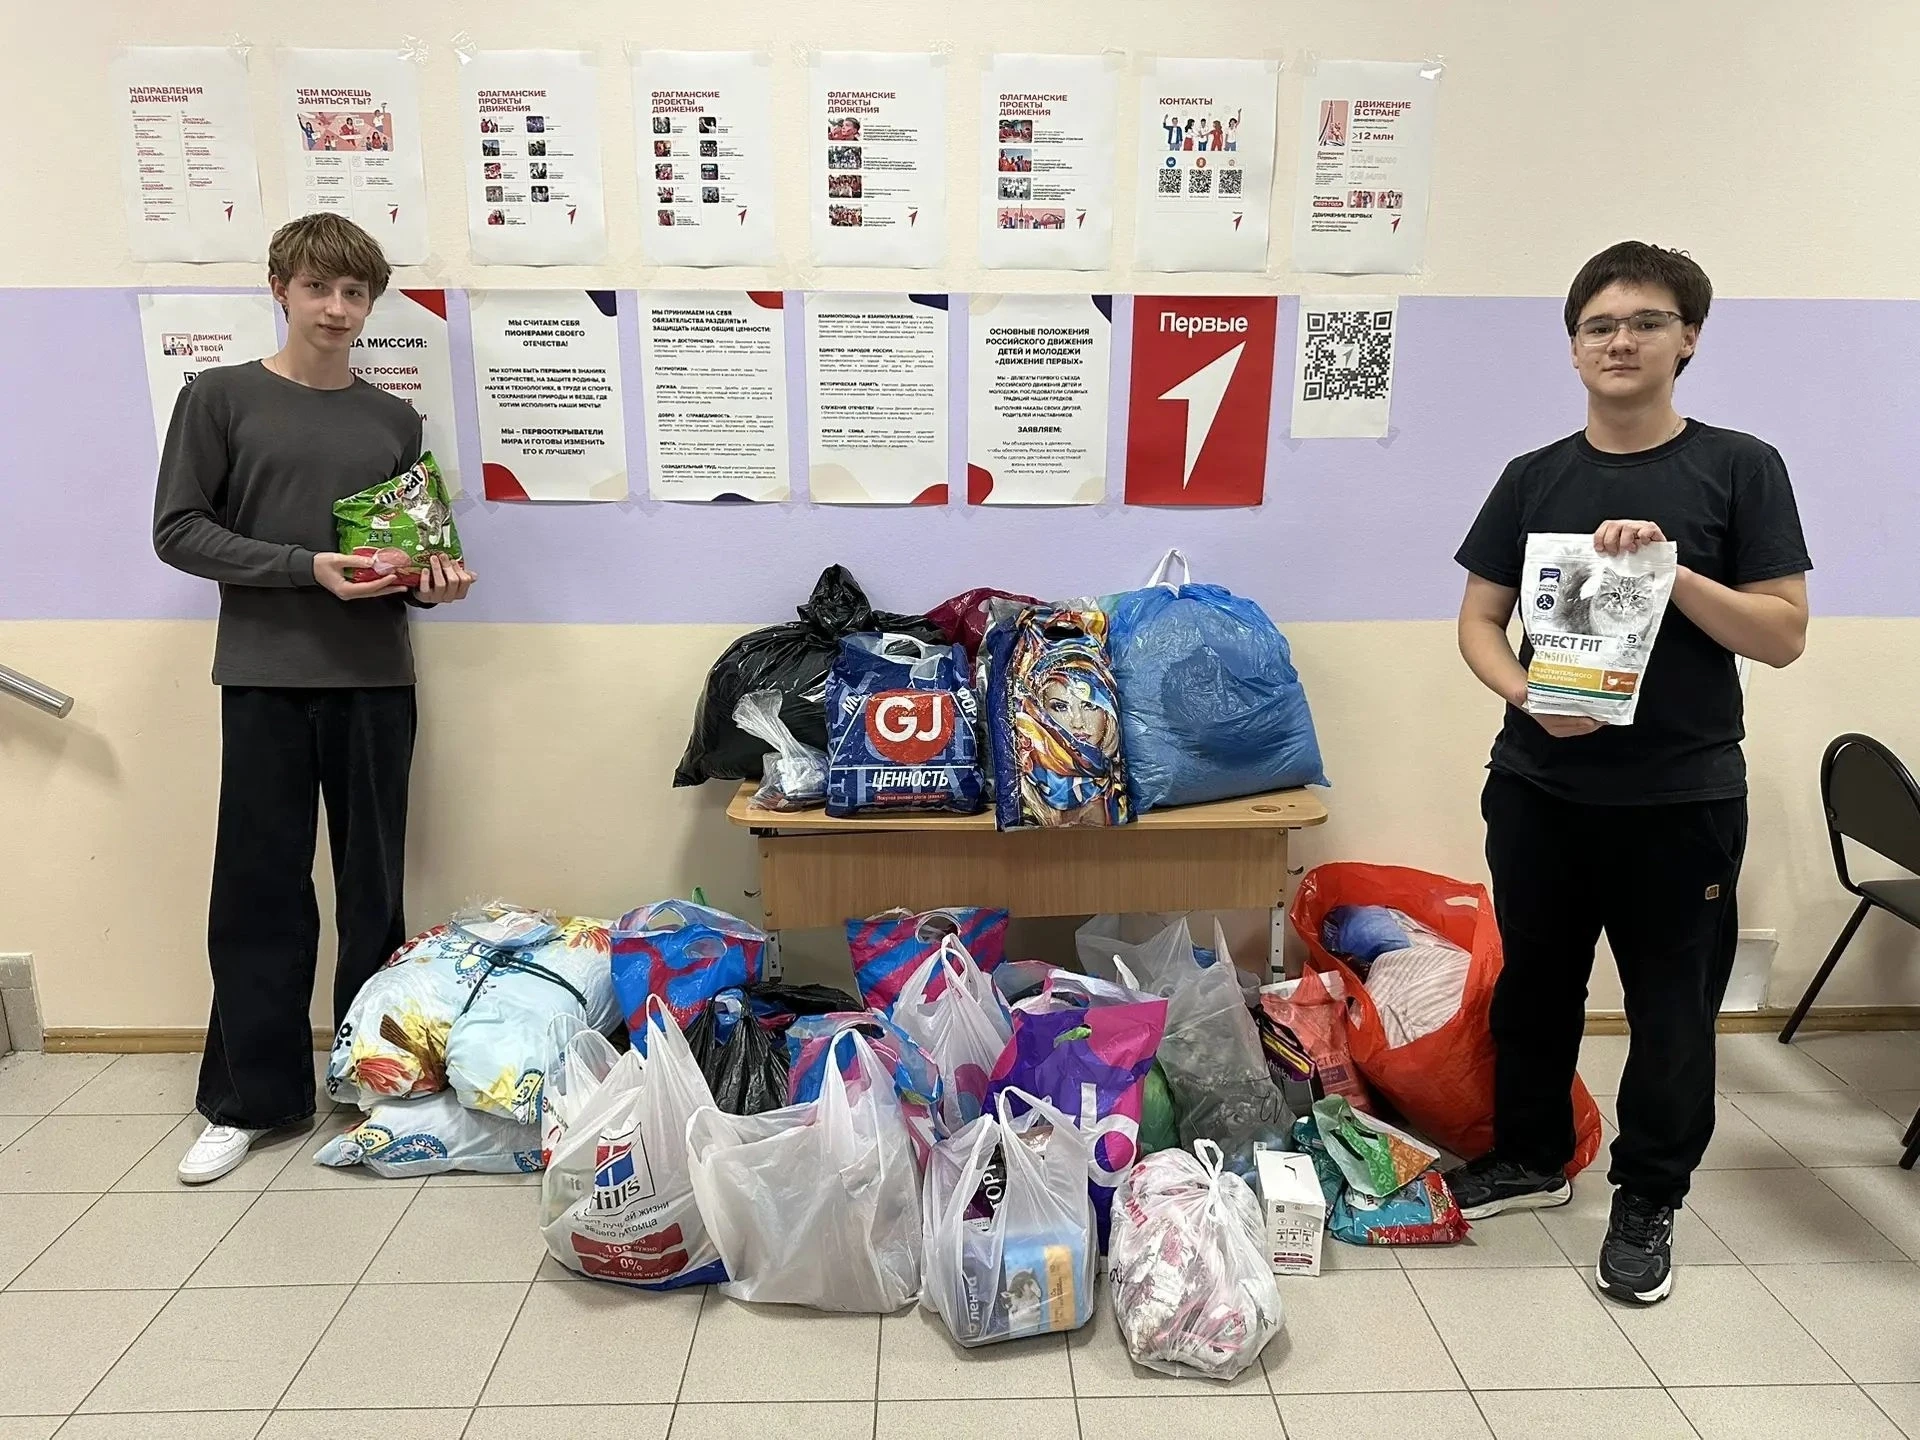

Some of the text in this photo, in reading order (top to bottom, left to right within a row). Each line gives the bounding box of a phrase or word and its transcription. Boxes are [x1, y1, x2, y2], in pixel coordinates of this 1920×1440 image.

[321, 89, 371, 97] МОЖЕШЬ
[827, 91, 896, 100] ФЛАГМАНСКИЕ
[130, 95, 188, 104] ДВИЖЕНИЯ
[298, 97, 350, 105] ЗАНЯТЬСЯ
[652, 98, 695, 106] ПРОЕКТЫ
[1000, 94, 1068, 102] ФЛАГМАНСКИЕ
[479, 105, 531, 113] ДВИЖЕНИЯ
[1354, 100, 1411, 110] ДВИЖЕНИЕ
[652, 106, 704, 114] ДВИЖЕНИЯ
[827, 106, 879, 114] ДВИЖЕНИЯ
[1362, 109, 1400, 117] СТРАНЕ
[1352, 132, 1371, 140] >12
[1160, 312, 1248, 338] Первые
[367, 338, 427, 348] МИССИЯ:
[986, 337, 1093, 346] РОССИЙСКОГО ДВИЖЕНИЯ
[201, 344, 224, 352] ТВОЕЙ
[998, 347, 1023, 356] ДЕТЕЙ
[1032, 348, 1081, 356] МОЛОДЕЖИ
[995, 358, 1044, 366] «ДВИЖЕНИЕ
[374, 366, 418, 374] РОССИЕЙ
[1627, 634, 1637, 643] 5
[1580, 639, 1602, 652] FIT
[876, 697, 942, 742] GJ
[872, 771, 948, 791] ЦЕННОСТЬ
[639, 1202, 669, 1218] жизни
[620, 1258, 642, 1271] 0%
